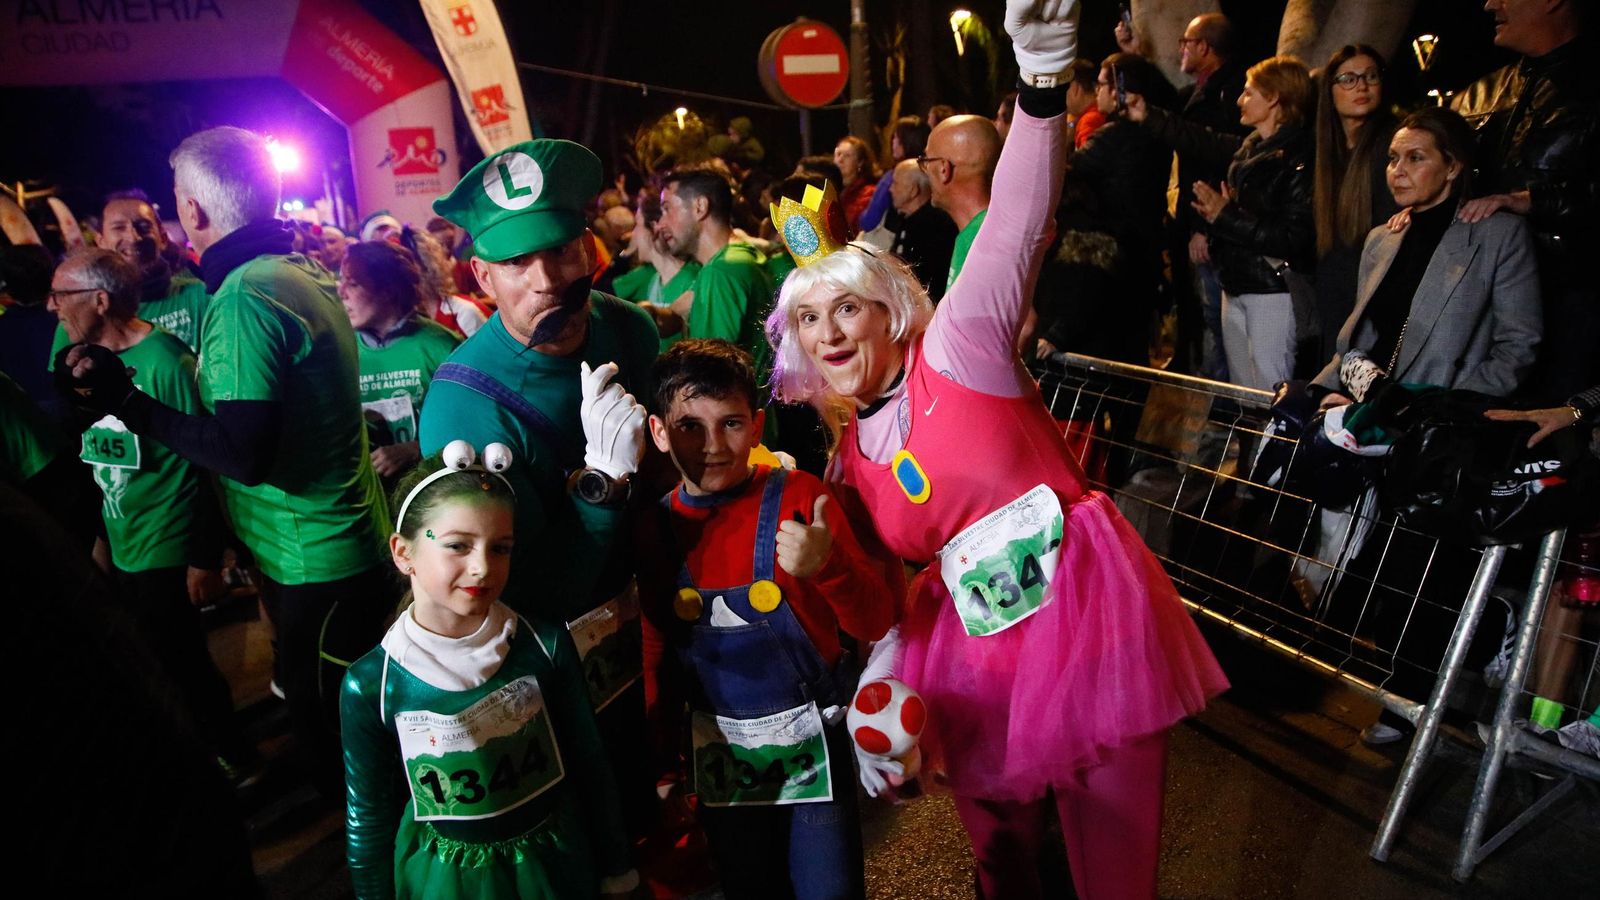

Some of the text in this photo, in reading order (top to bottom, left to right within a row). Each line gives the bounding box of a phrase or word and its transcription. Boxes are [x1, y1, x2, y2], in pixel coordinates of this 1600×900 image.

[22, 31, 130, 54] CIUDAD
[326, 46, 384, 95] deporte
[498, 163, 533, 200] L
[371, 381, 382, 391] DE
[376, 369, 421, 381] SILVESTRE
[91, 436, 126, 459] 145
[957, 524, 984, 544] SILVESTRE
[984, 509, 1007, 526] CIUDAD
[1008, 503, 1016, 512] DE
[748, 718, 773, 727] CIUDAD
[774, 715, 783, 723] DE
[705, 753, 818, 790] 1343
